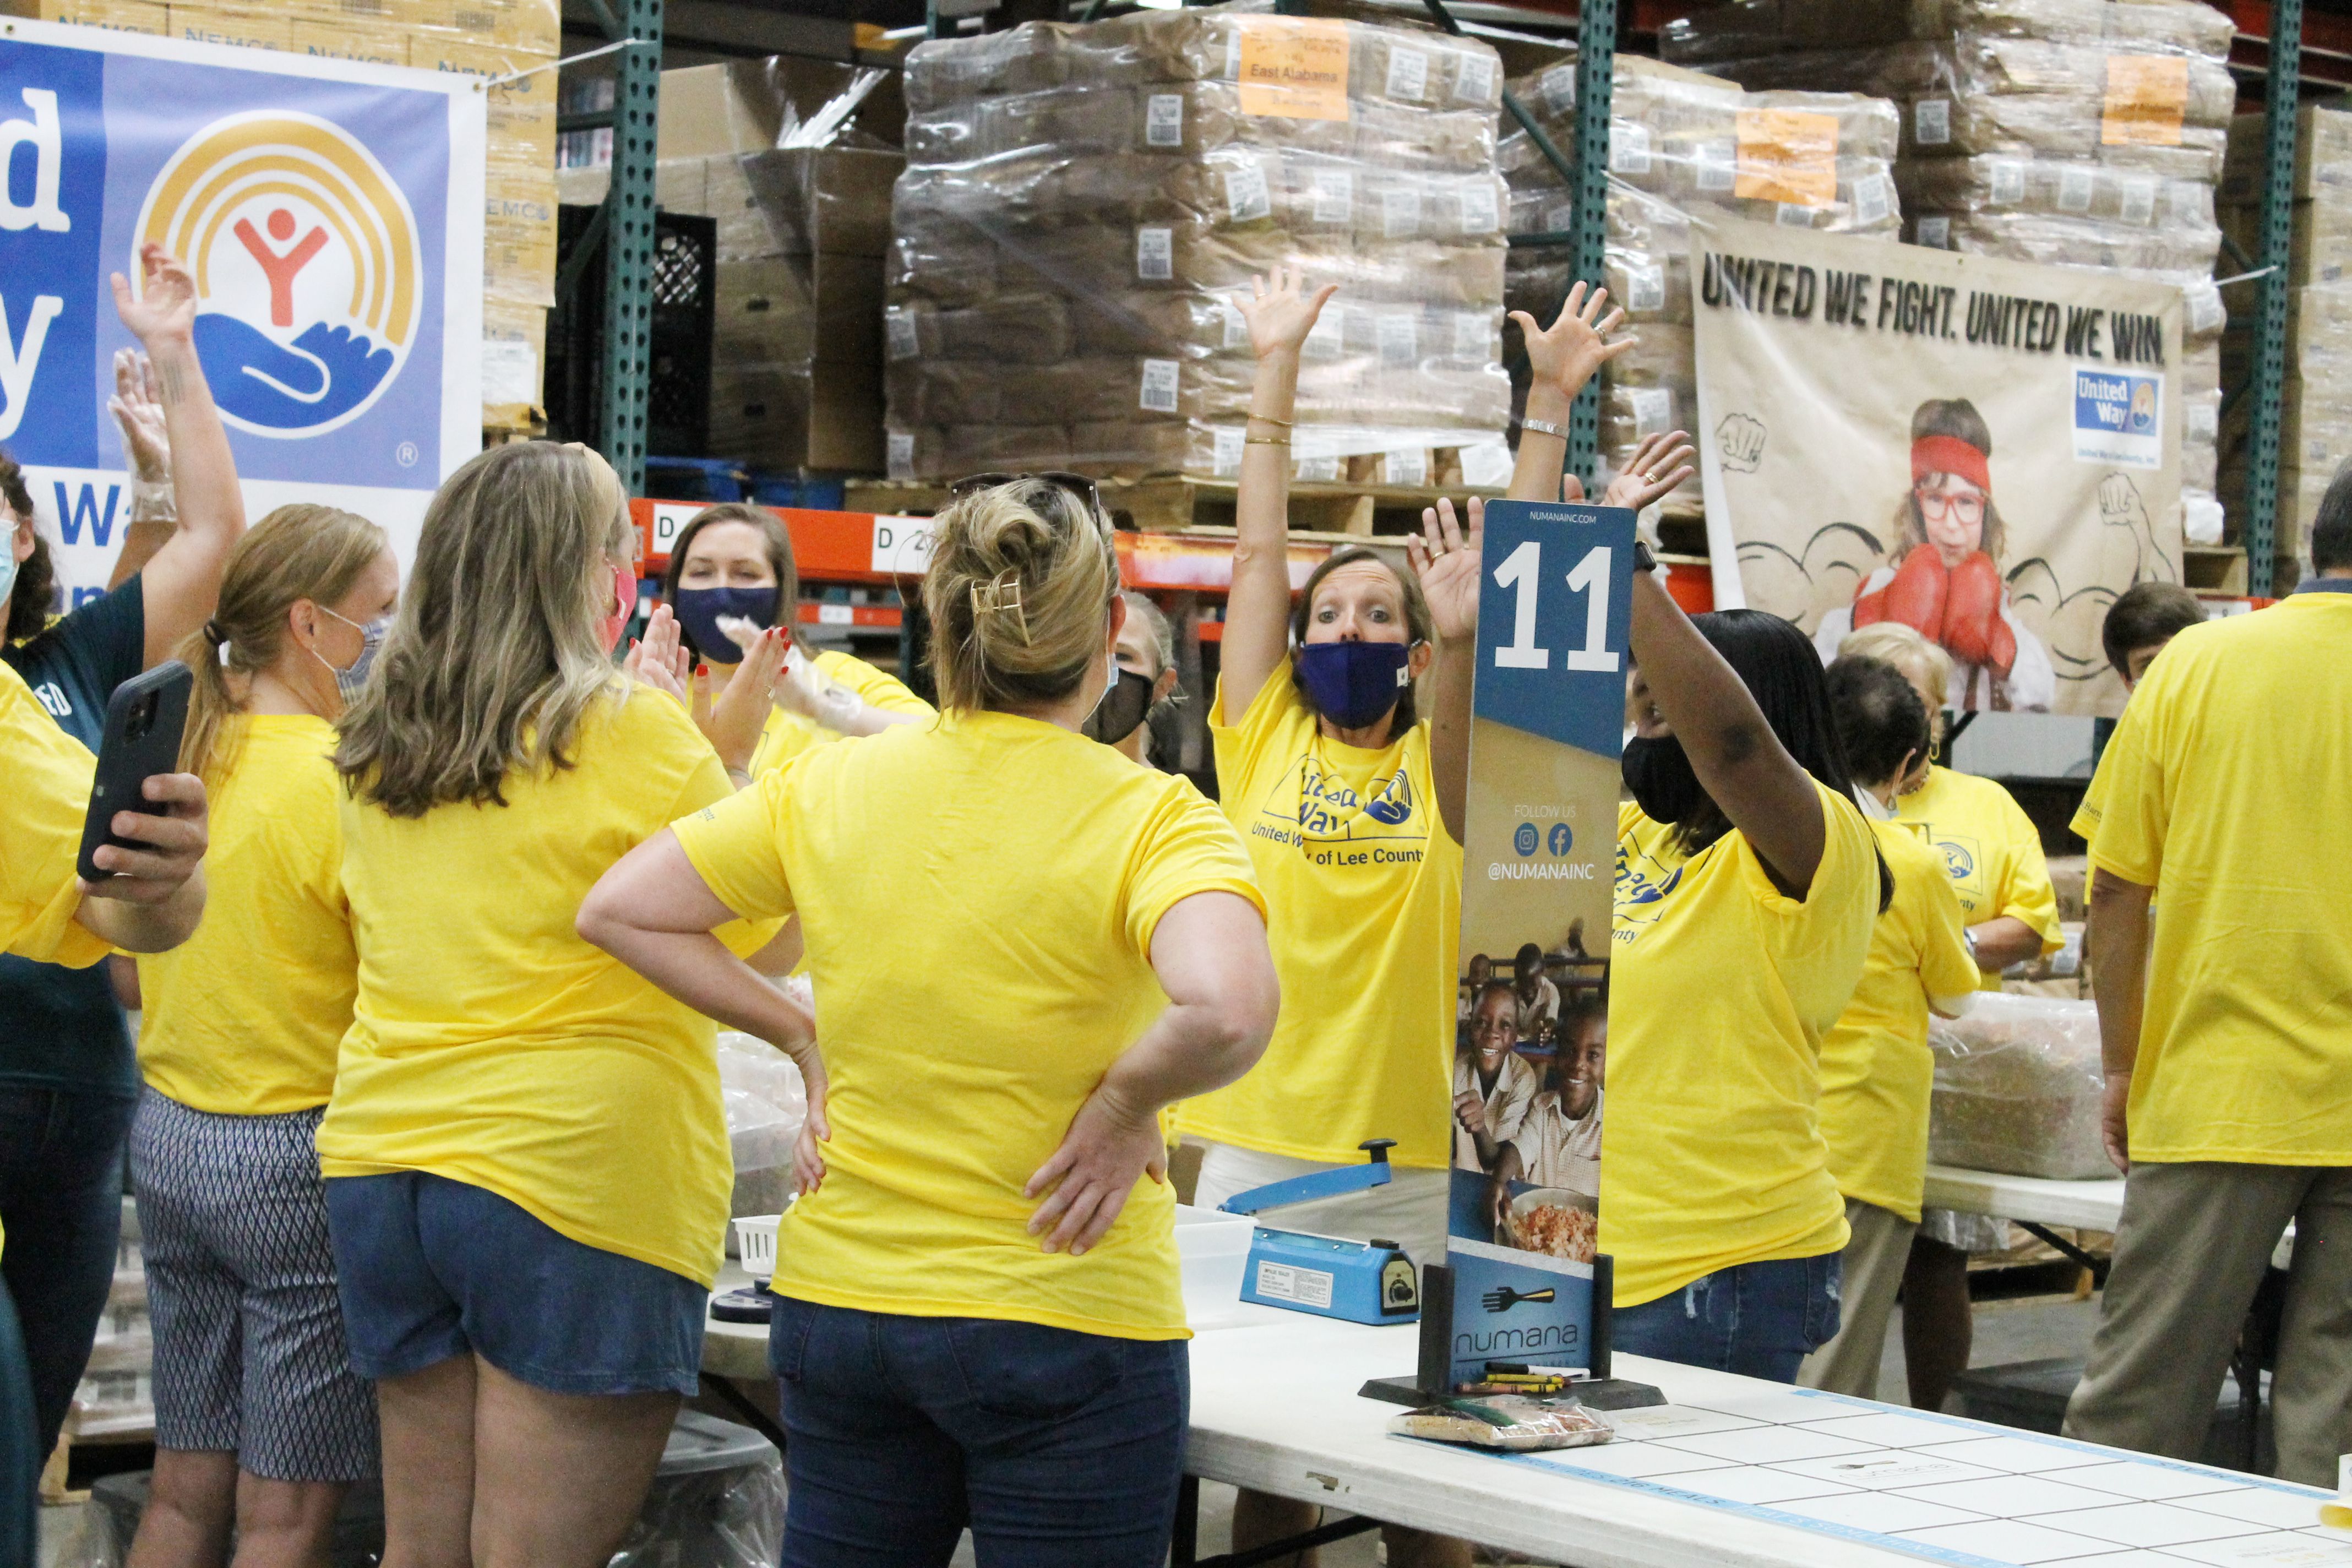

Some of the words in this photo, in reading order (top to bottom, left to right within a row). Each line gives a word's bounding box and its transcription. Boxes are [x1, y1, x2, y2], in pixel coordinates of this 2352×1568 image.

[1250, 63, 1278, 78] East
[1282, 67, 1338, 83] Alabama
[1702, 252, 1816, 318] UNITED
[1825, 269, 1871, 326] WE
[1877, 277, 1956, 339] FIGHT.
[1966, 291, 2060, 351] UNITED
[2064, 305, 2104, 358] WE
[2111, 311, 2165, 367] WIN.
[2078, 377, 2128, 401] United
[2096, 401, 2127, 430] Way
[660, 516, 674, 538] D
[1529, 511, 1597, 524] NUMANAINC.COM
[879, 527, 893, 549] D
[1493, 541, 1620, 672] 11
[1515, 804, 1560, 818] FOLLOW
[1562, 805, 1576, 818] US
[1251, 821, 1290, 844] United
[1316, 851, 1332, 865] of
[1337, 851, 1368, 865] Lee
[1488, 862, 1595, 881] @NUMANAINC
[1456, 1324, 1578, 1354] numana
[1649, 1485, 1726, 1506] MEALS
